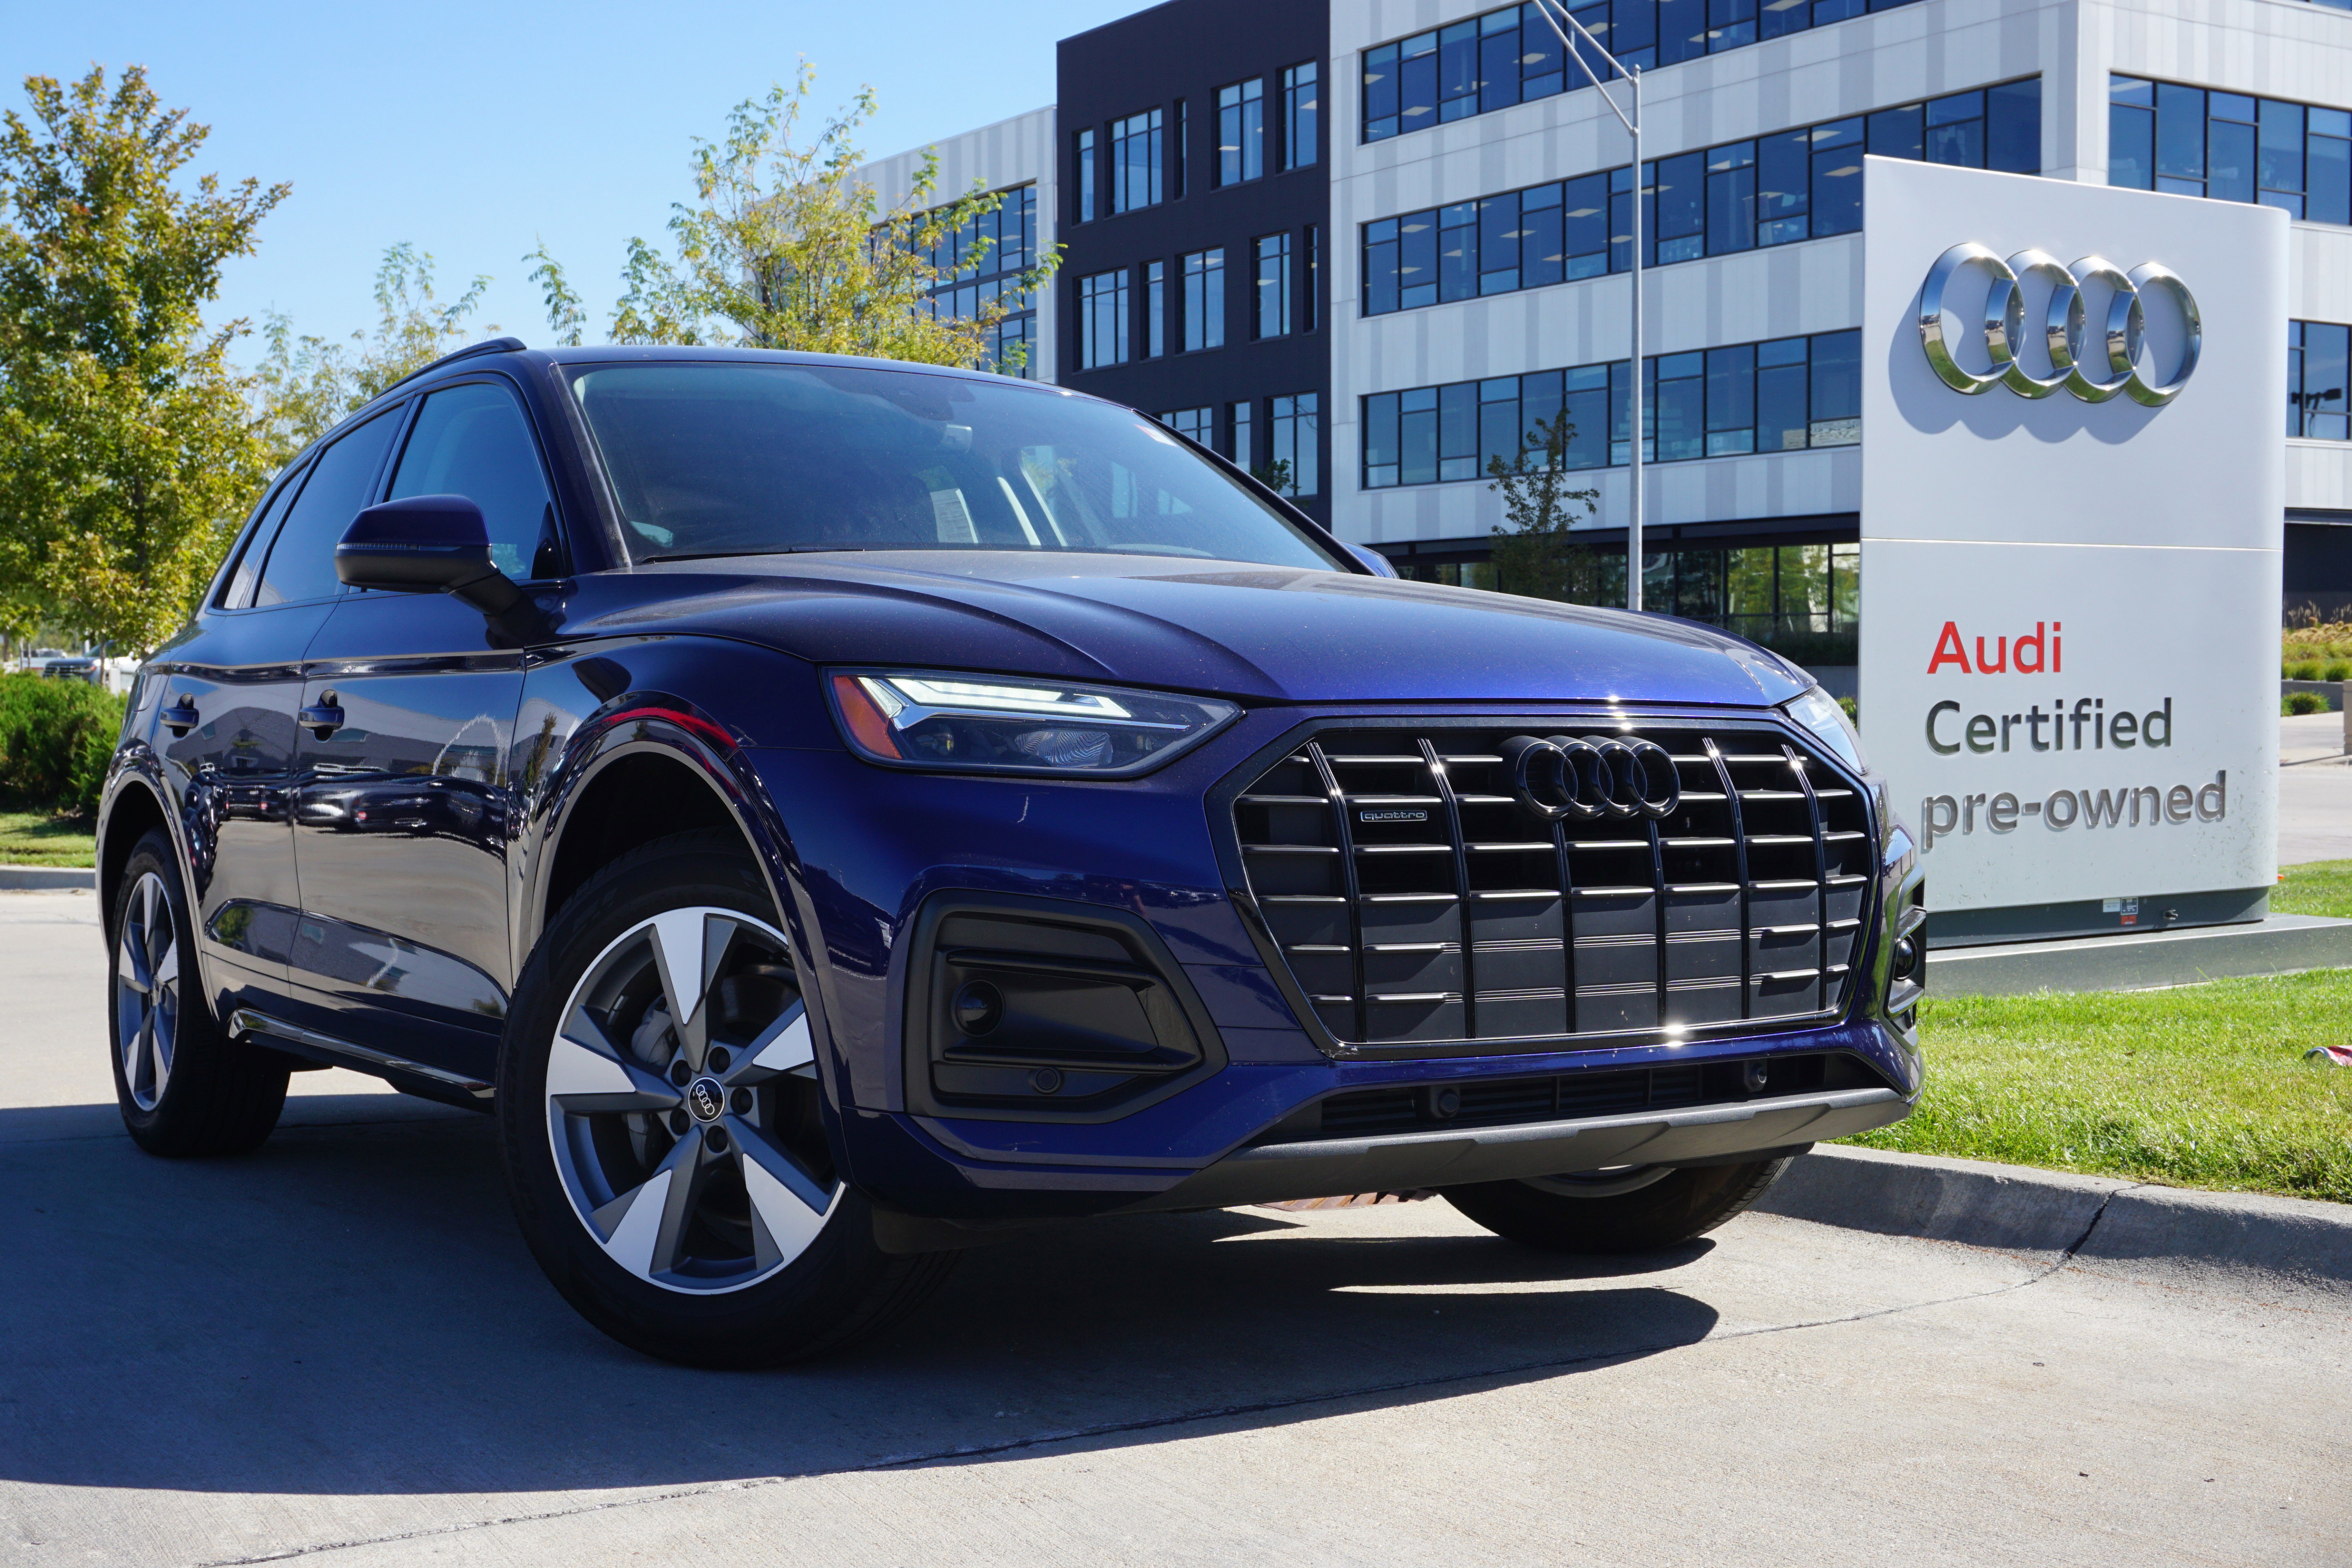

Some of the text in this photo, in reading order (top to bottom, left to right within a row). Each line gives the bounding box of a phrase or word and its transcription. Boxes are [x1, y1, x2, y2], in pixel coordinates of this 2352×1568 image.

[1927, 621, 2061, 674] Audi
[1925, 697, 2172, 755] Certified
[1365, 812, 1425, 820] quattro
[1921, 770, 2226, 853] pre-owned
[760, 931, 787, 950] Audi Sport
[505, 1040, 541, 1220] CRUGEN
